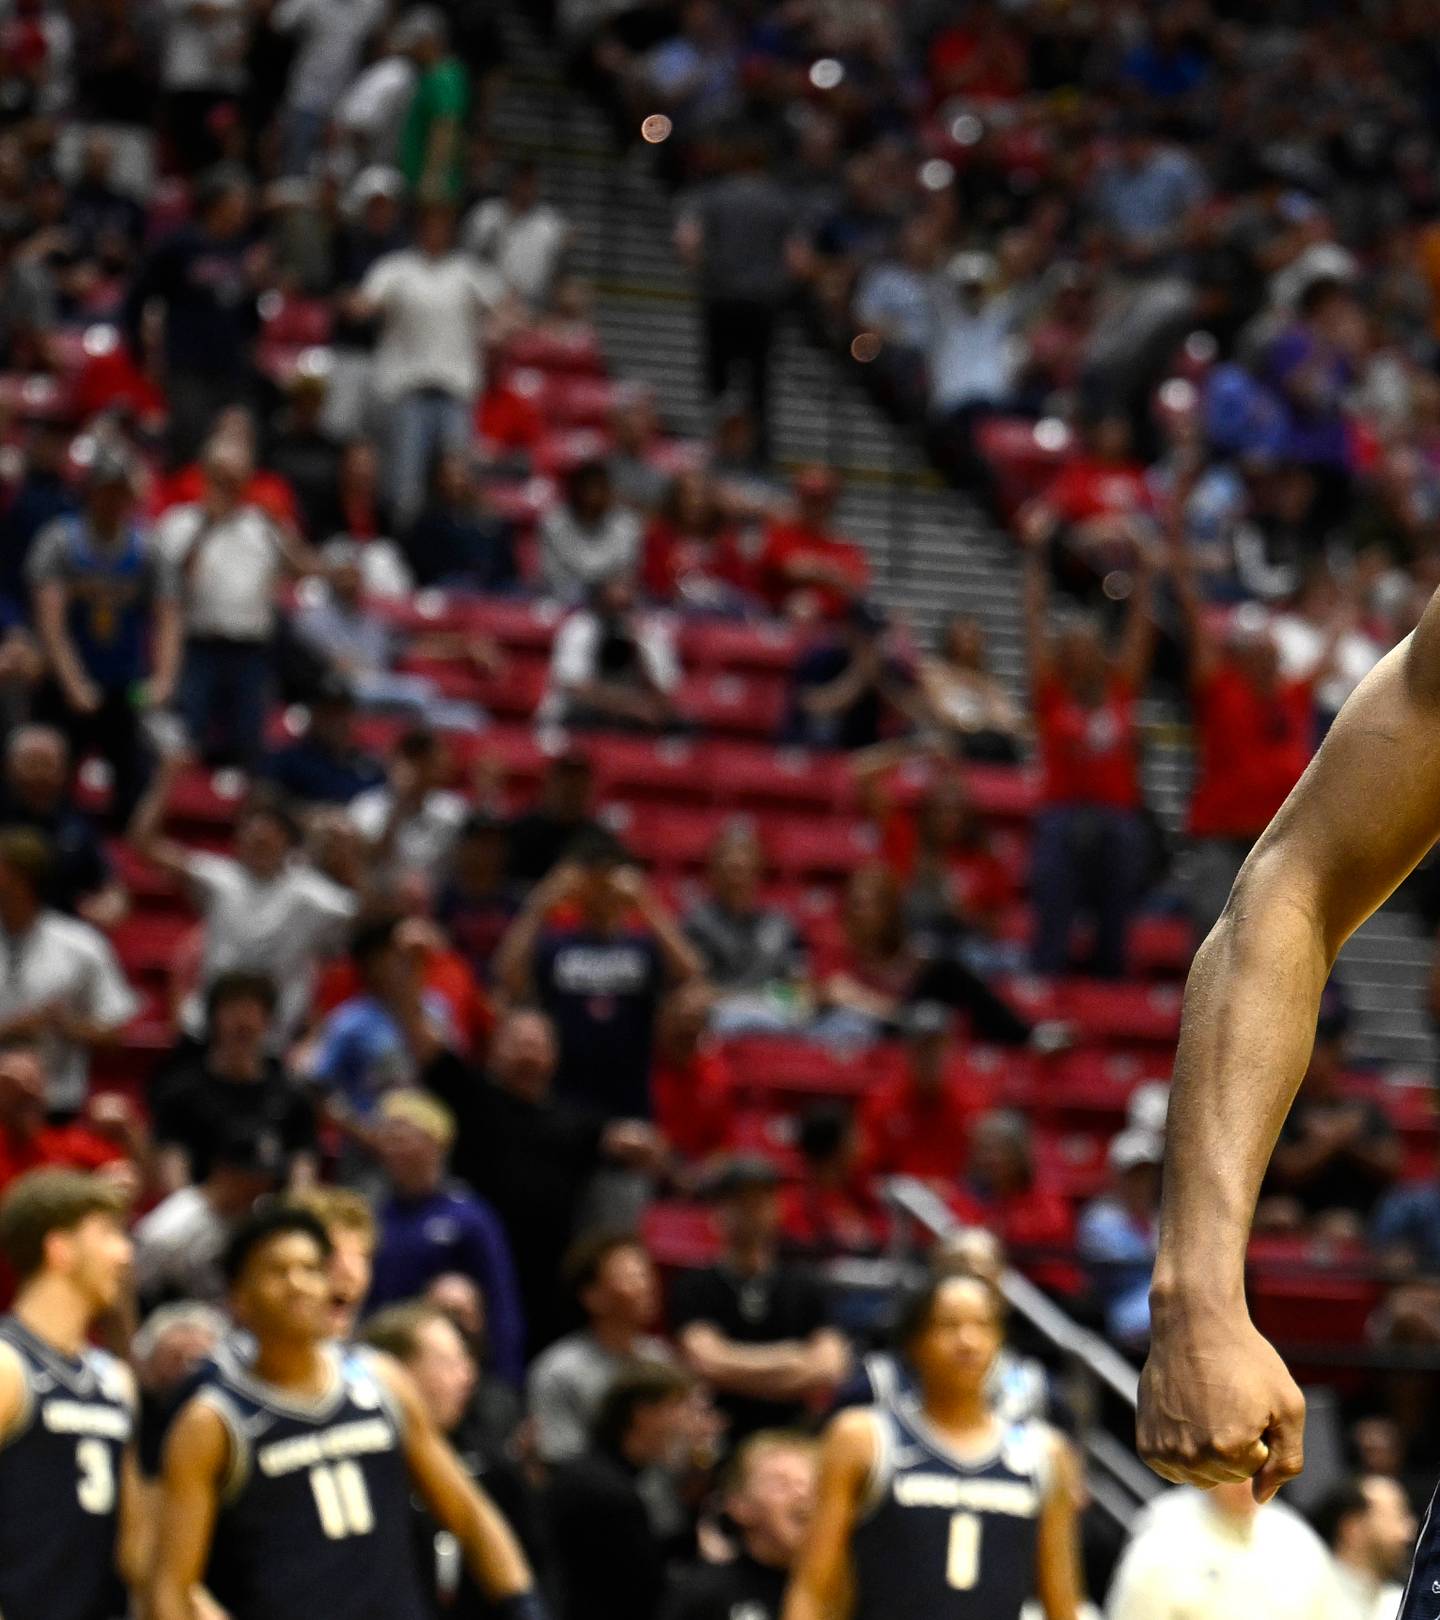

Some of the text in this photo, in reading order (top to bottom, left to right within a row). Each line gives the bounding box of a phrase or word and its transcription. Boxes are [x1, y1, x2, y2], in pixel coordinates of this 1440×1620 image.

[77, 1439, 114, 1515] 3
[310, 1461, 373, 1539] 11
[948, 1512, 981, 1590] 1
